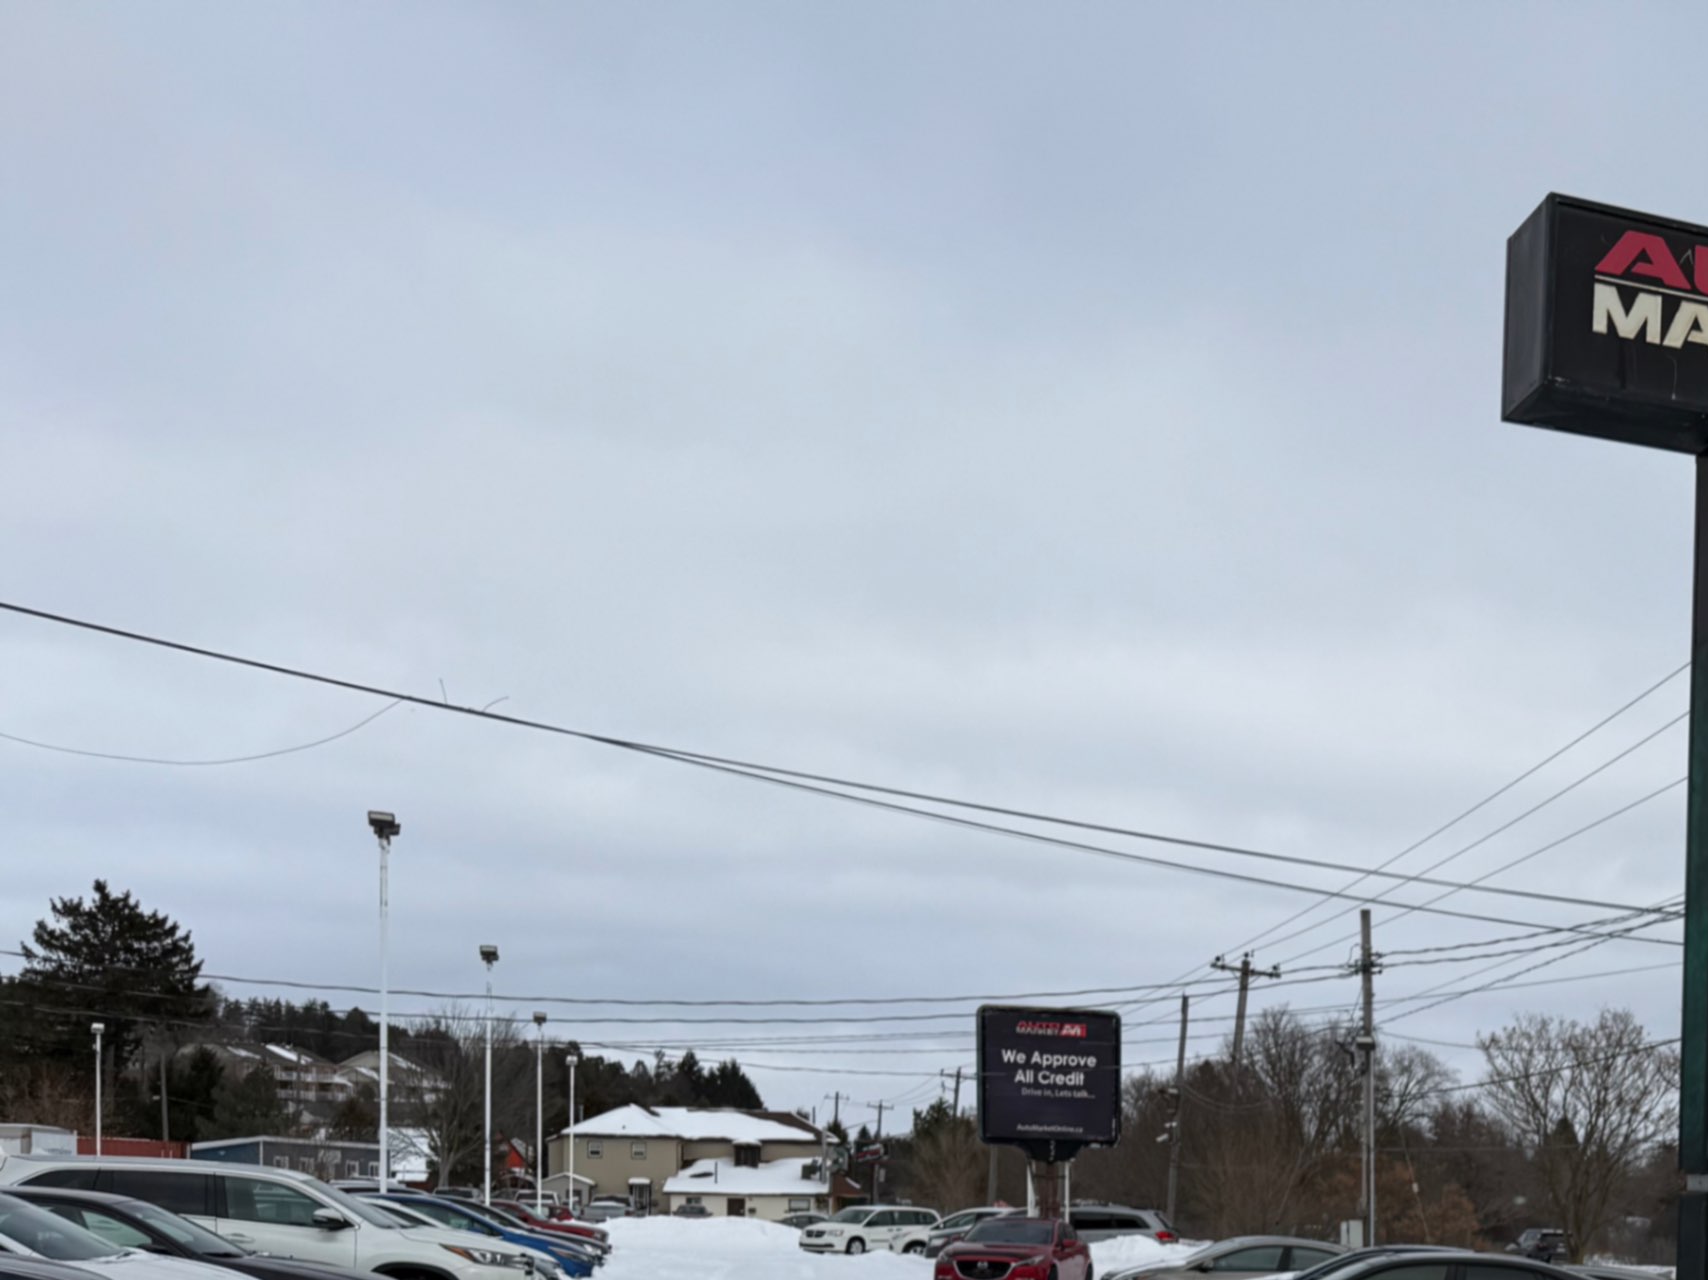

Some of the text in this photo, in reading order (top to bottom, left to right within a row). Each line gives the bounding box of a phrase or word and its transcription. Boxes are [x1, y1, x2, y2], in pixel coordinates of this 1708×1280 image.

[1001, 1049, 1097, 1068] We Approve
[1014, 1069, 1085, 1086] All Credit
